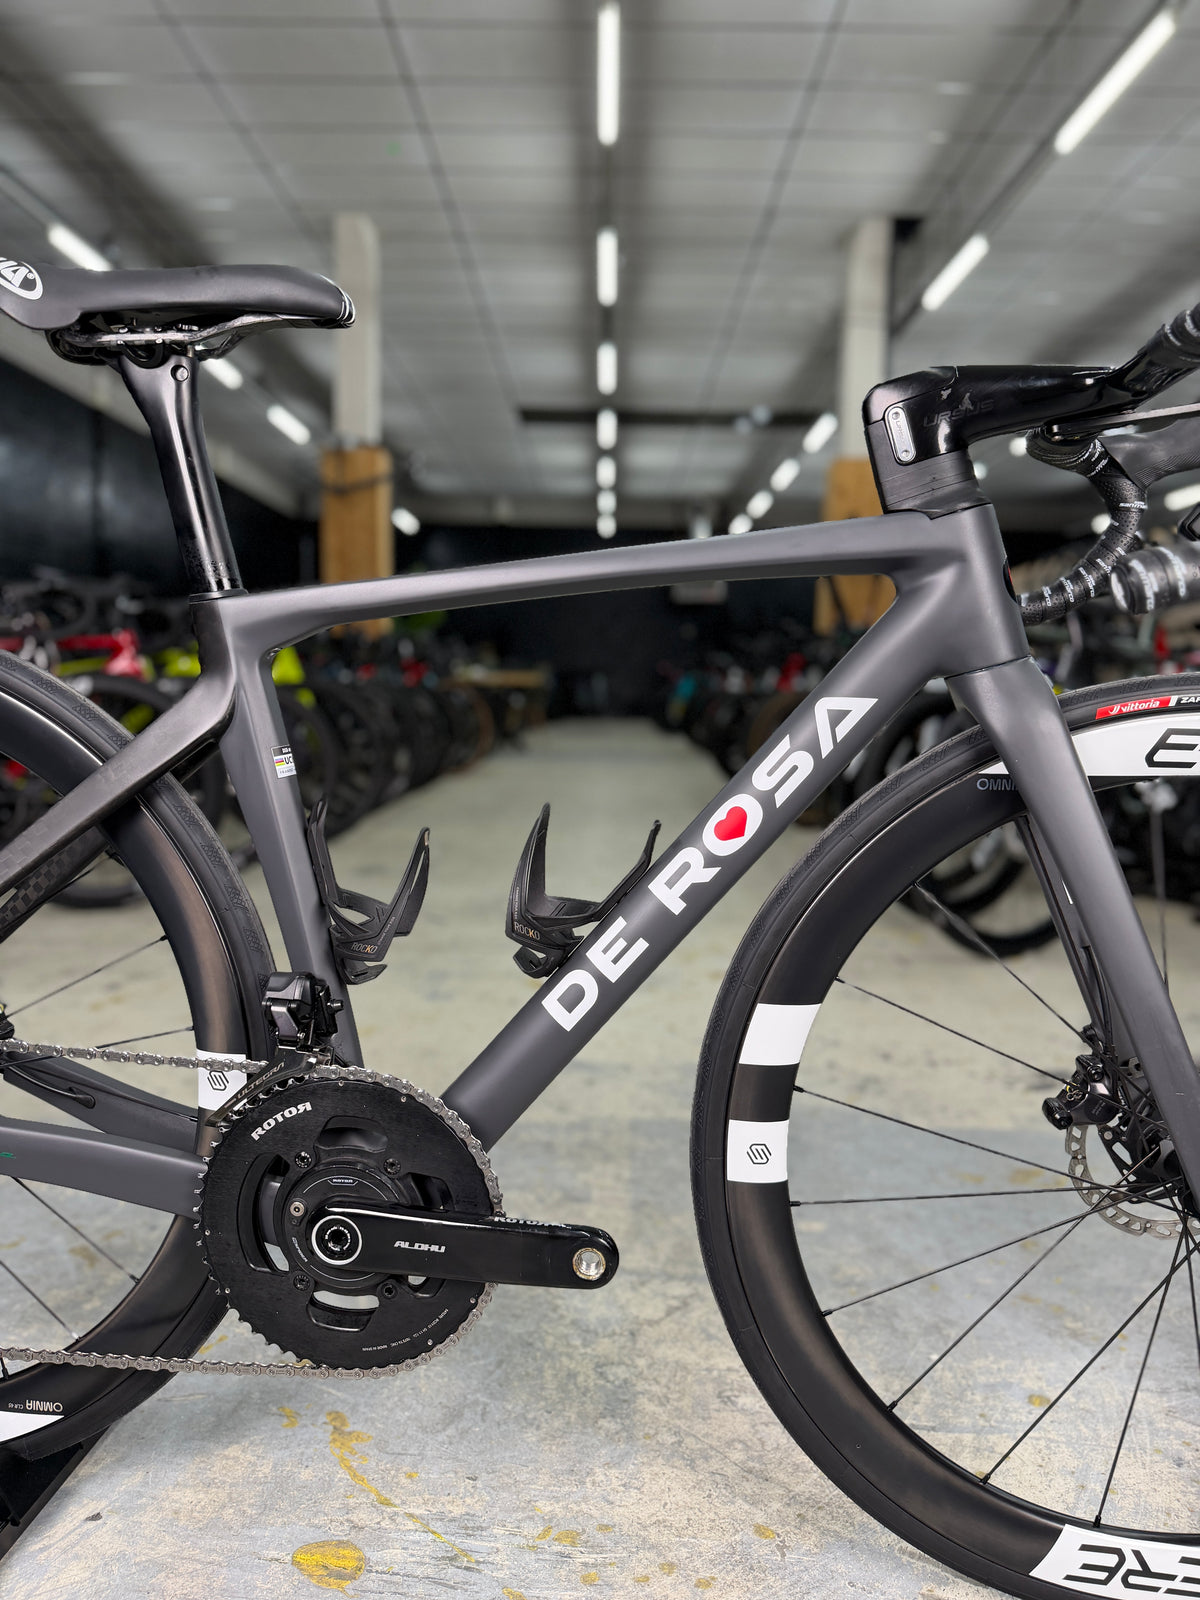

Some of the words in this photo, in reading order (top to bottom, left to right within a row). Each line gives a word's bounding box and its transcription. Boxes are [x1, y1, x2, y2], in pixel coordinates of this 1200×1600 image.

[923, 400, 994, 428] URSUS
[1121, 699, 1160, 712] vittoria
[541, 915, 649, 1032] DE
[648, 696, 878, 916] ROSA
[513, 921, 541, 941] ROCKO
[351, 941, 378, 954] ROCKO
[236, 1061, 286, 1099] ULTEGRA
[250, 1101, 313, 1141] ROTOR
[393, 1239, 446, 1254] ALDHU
[26, 1399, 63, 1413] OMNIA
